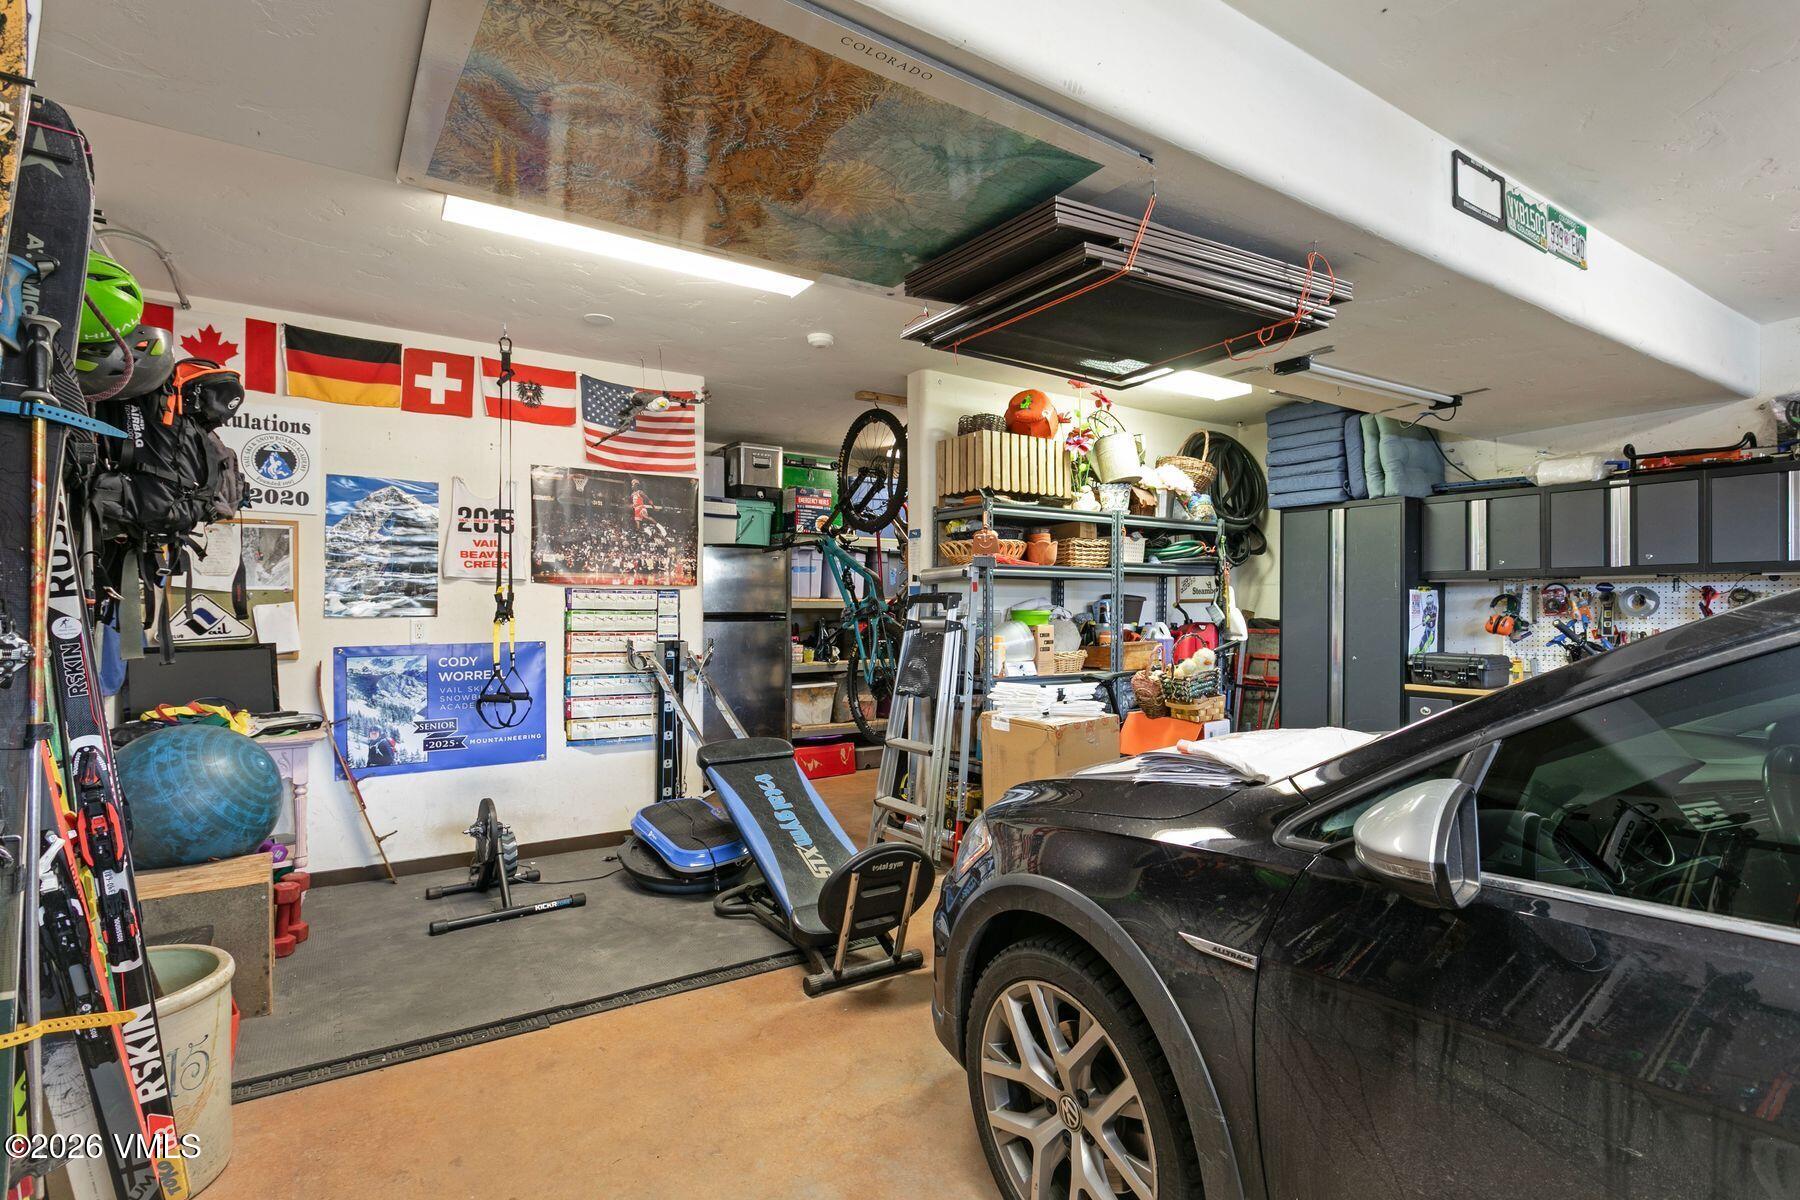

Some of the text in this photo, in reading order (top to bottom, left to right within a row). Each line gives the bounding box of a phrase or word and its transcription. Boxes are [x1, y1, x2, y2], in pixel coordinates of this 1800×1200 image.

[840, 36, 933, 81] COLORADO
[131, 404, 144, 448] AIRBAG
[250, 487, 310, 507] 2020
[457, 506, 515, 535] 2015
[60, 642, 89, 699] RSKIN
[438, 656, 479, 668] CODY
[440, 702, 489, 711] ACADEY
[419, 721, 456, 731] SENIOR
[469, 733, 542, 745] MOUNTAINEERING
[754, 773, 794, 812] total
[774, 809, 814, 847] gym
[872, 860, 905, 872] total gym
[534, 901, 559, 911] KICKR
[1212, 946, 1254, 964] ALLTRACK
[122, 1003, 168, 1105] RSKIN
